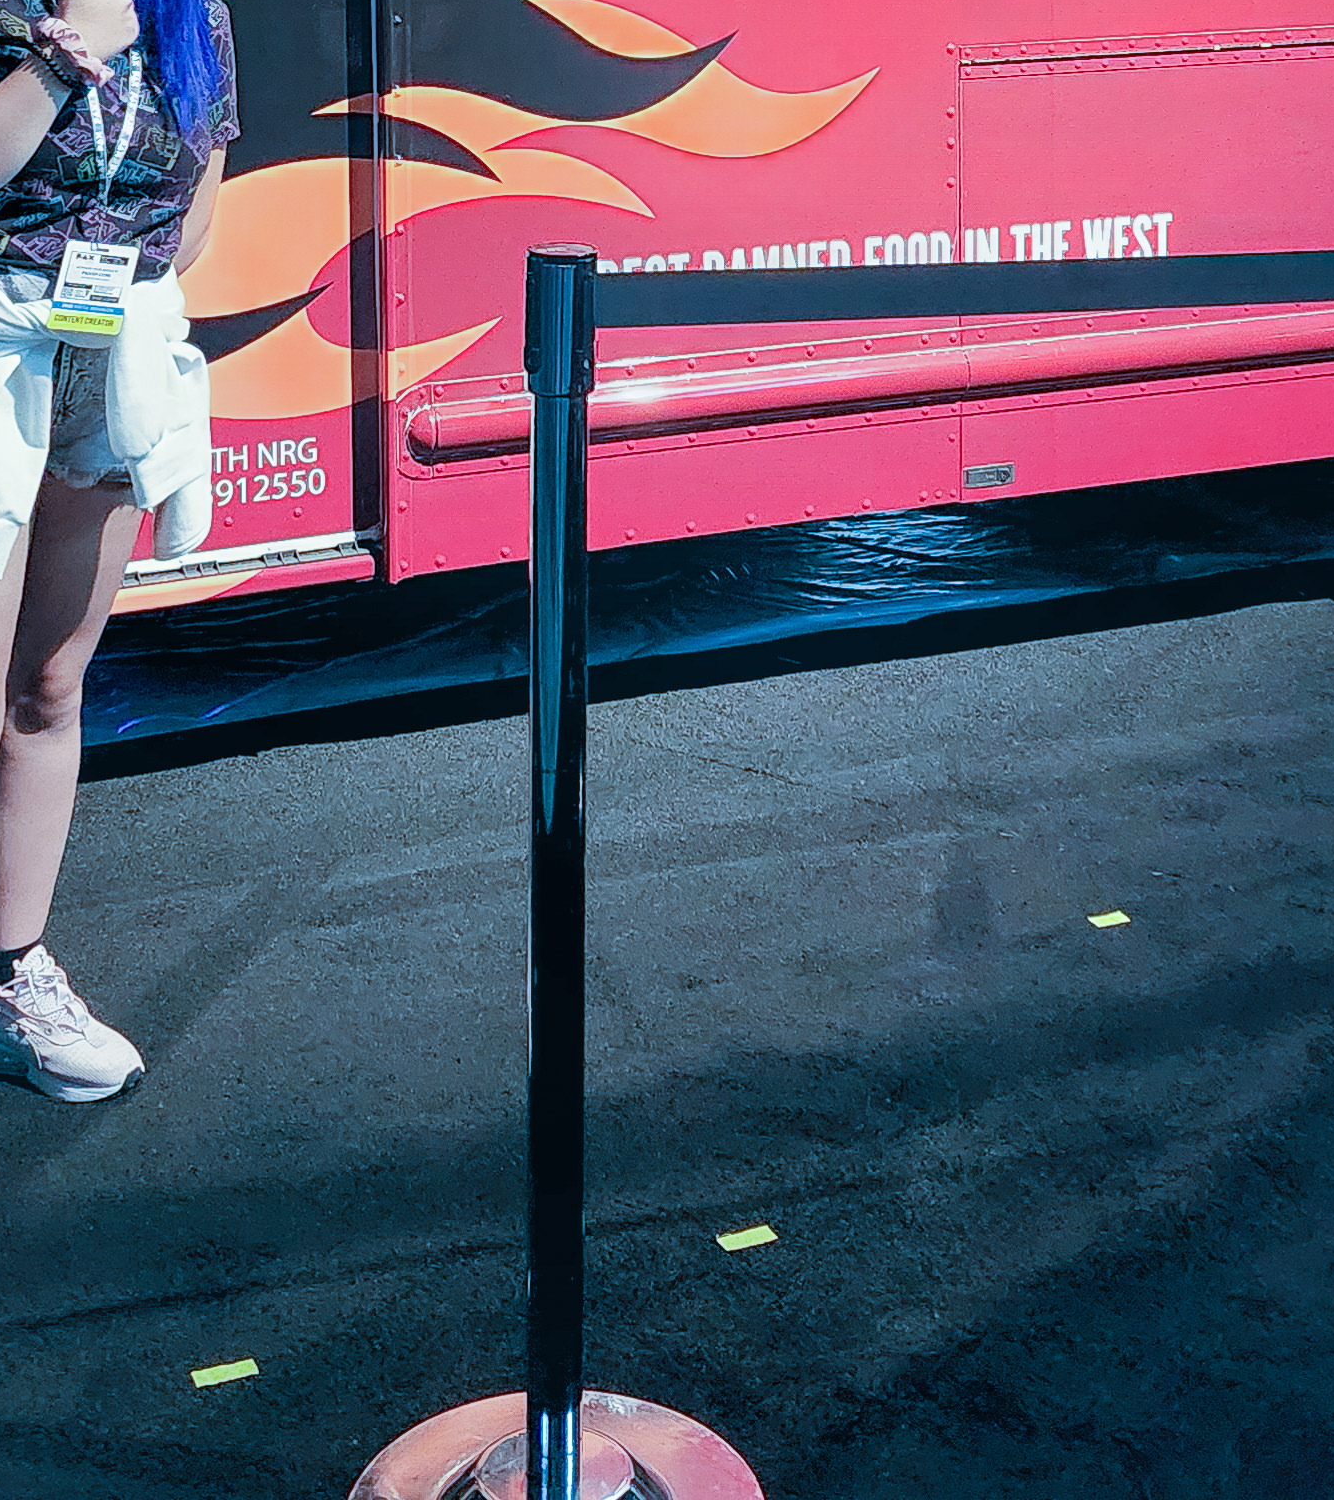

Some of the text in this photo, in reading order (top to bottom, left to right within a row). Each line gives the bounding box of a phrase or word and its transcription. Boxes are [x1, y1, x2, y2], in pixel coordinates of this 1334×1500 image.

[964, 227, 1000, 263] IN
[1010, 221, 1072, 261] THE
[1082, 212, 1174, 260] WEST
[211, 437, 318, 474] TH NRG
[210, 468, 326, 507] 912550
